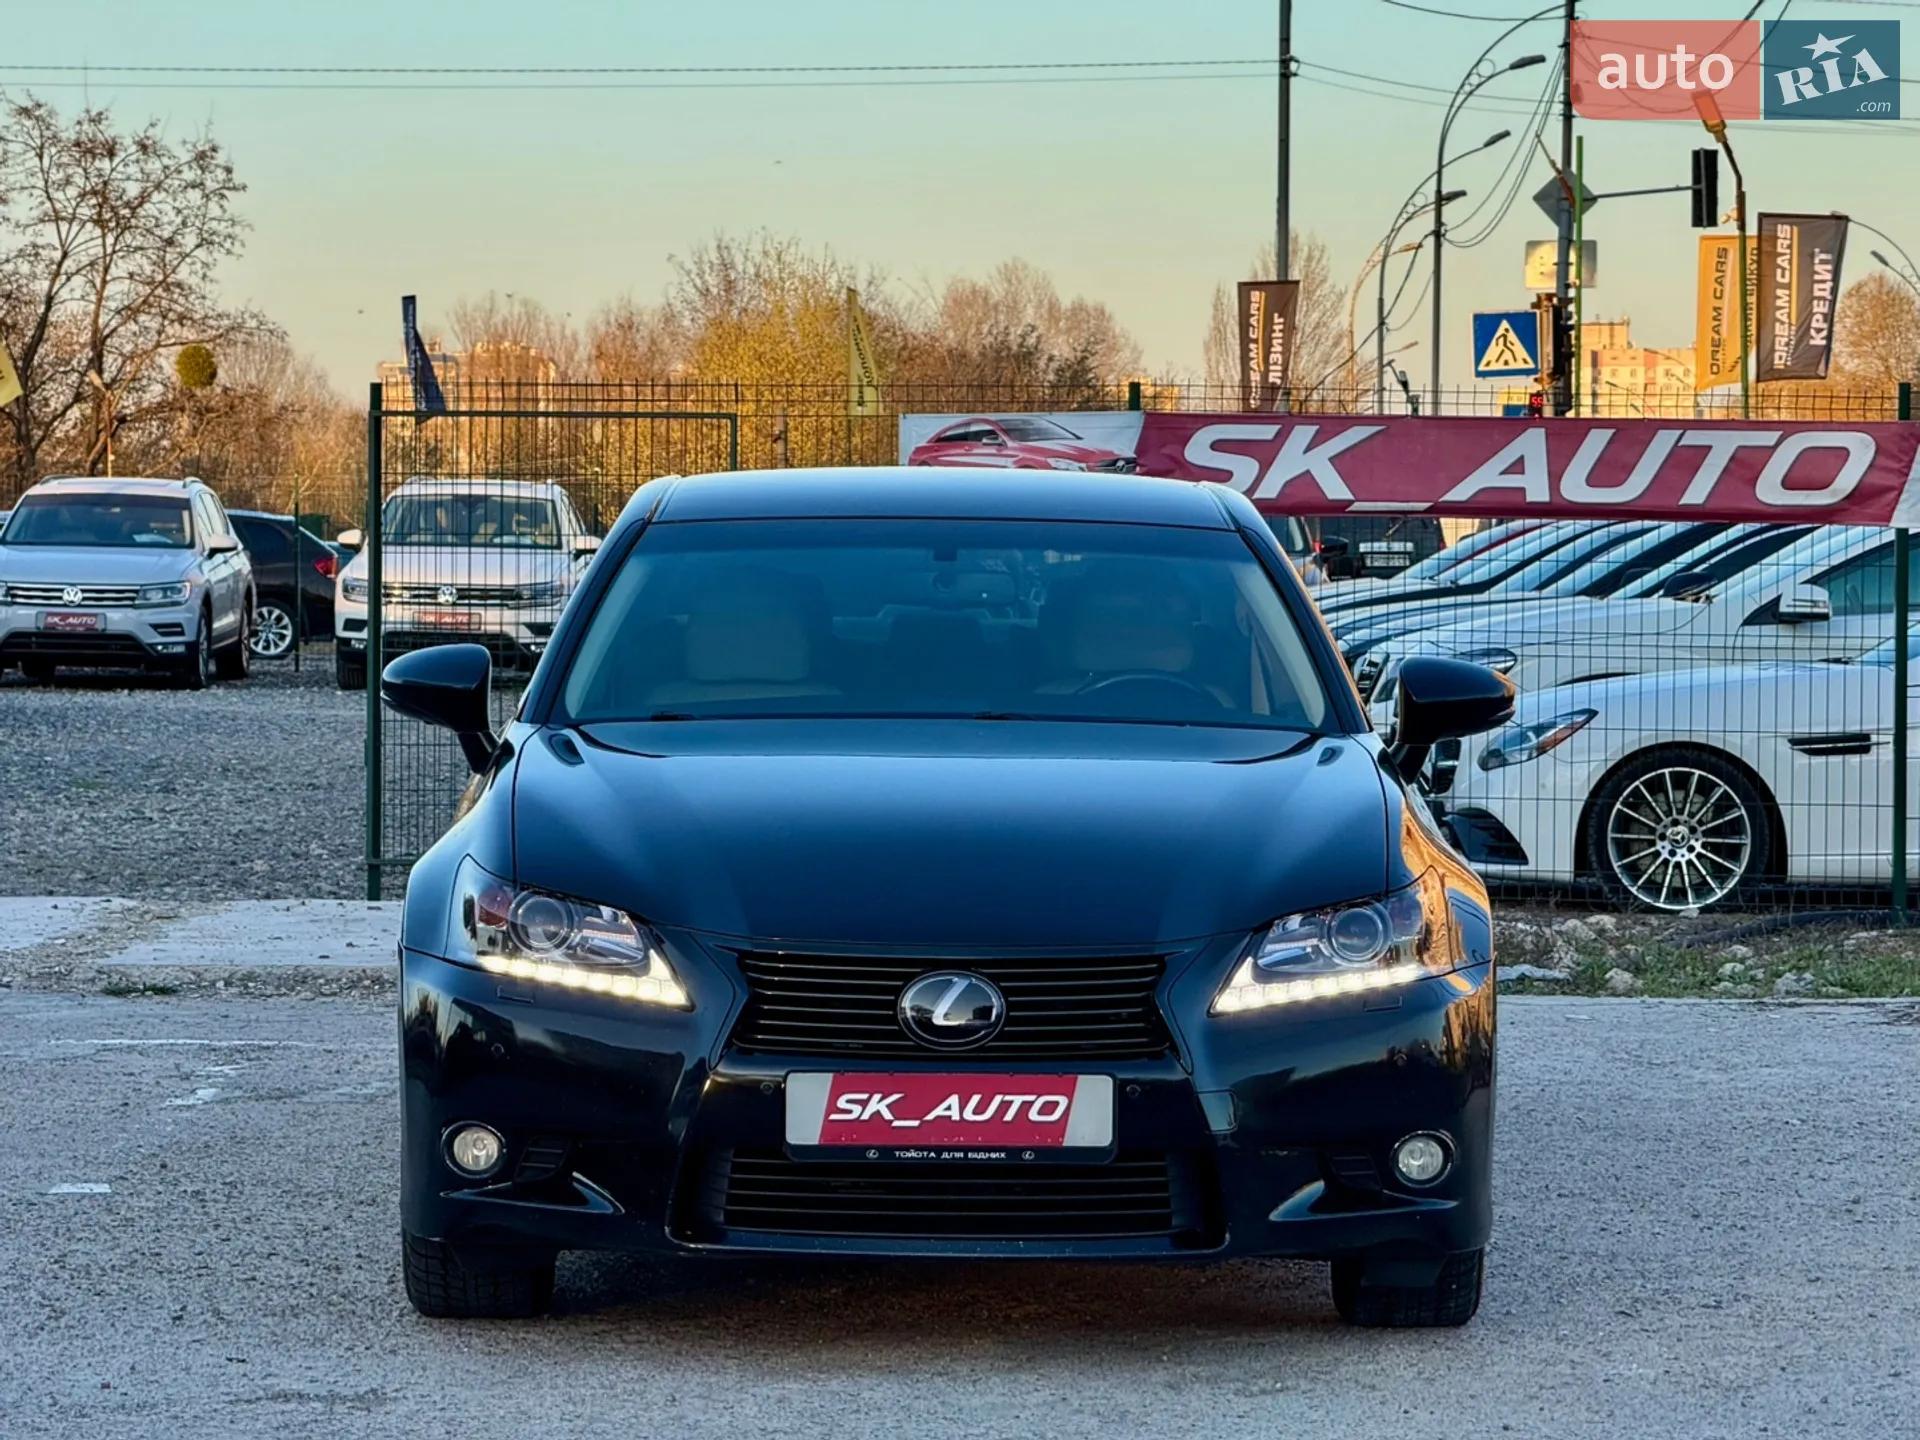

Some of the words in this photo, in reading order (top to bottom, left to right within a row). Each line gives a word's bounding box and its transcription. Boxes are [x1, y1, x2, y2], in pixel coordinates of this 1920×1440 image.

[1713, 247, 1728, 301] CARS
[1775, 224, 1791, 283] CARS
[1249, 290, 1260, 339] CARS
[1809, 248, 1833, 346] КРЕДИТ
[1710, 306, 1723, 375] DREAM
[1774, 288, 1790, 369] DREAM
[1184, 423, 1877, 511] SK_AUTO
[828, 1093, 1070, 1127] SK_AUTO
[894, 1149, 936, 1159] ТОЙОТА
[941, 1151, 964, 1159] ДЛЯ
